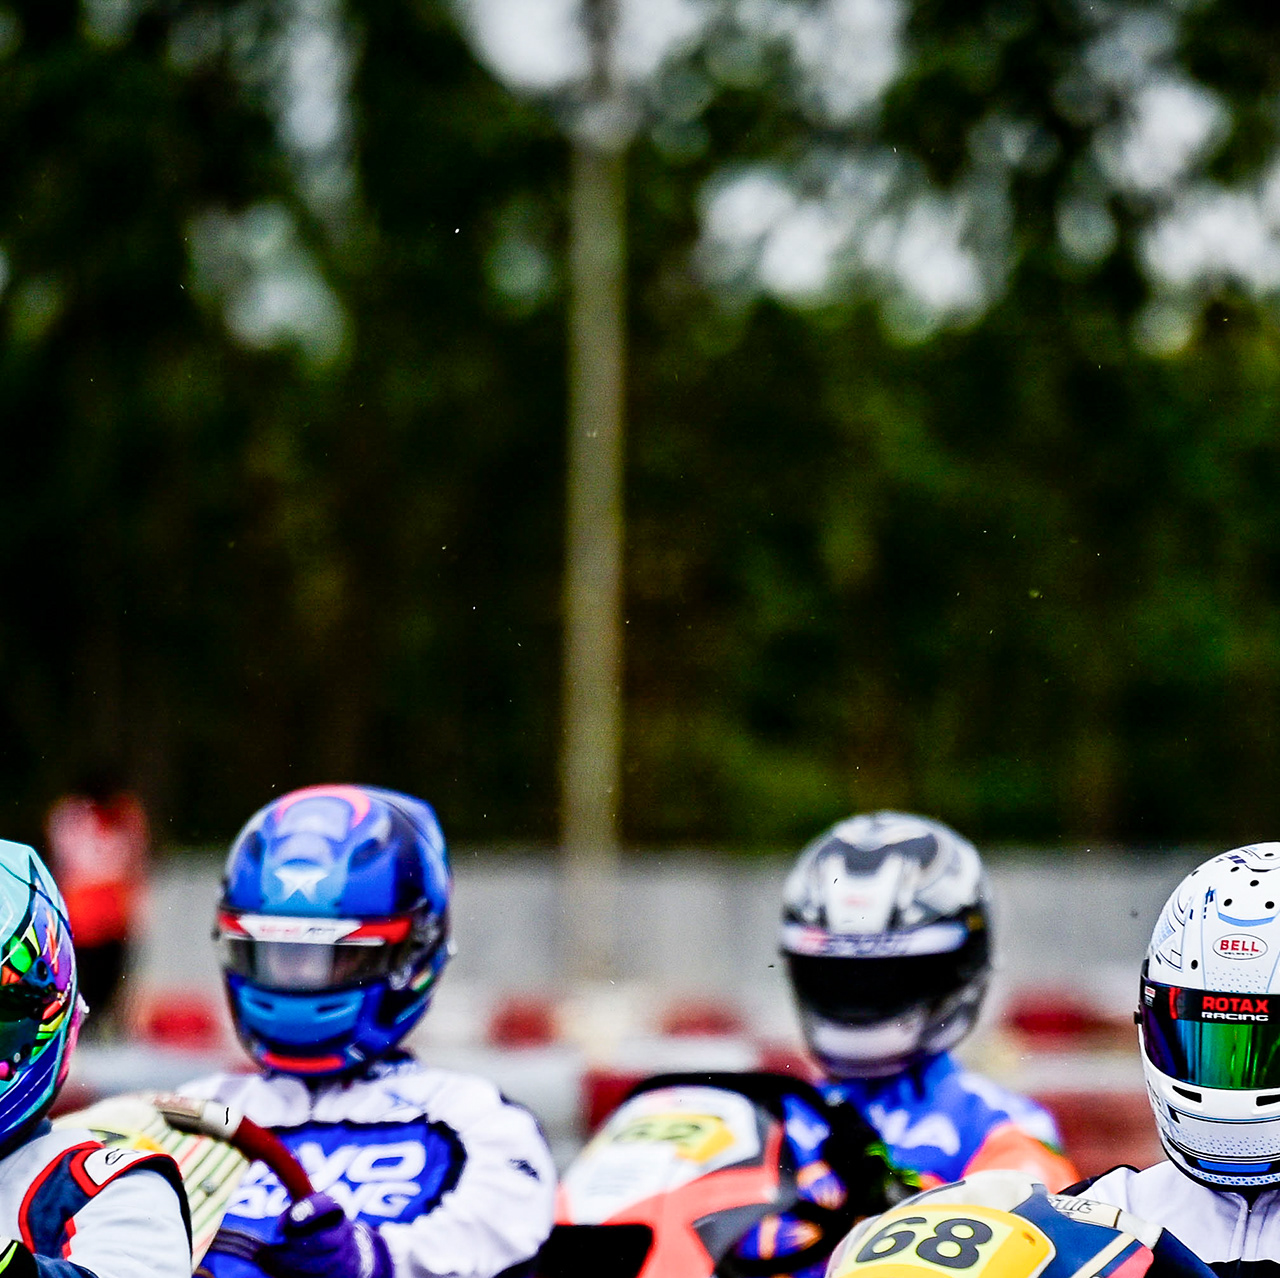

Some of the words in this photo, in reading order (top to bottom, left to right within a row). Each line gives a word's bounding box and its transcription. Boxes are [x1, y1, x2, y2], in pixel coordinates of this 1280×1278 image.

[1220, 939, 1260, 953] BELL
[1202, 996, 1269, 1013] ROTAX
[1201, 1011, 1269, 1022] RACING
[856, 1216, 993, 1269] 68
